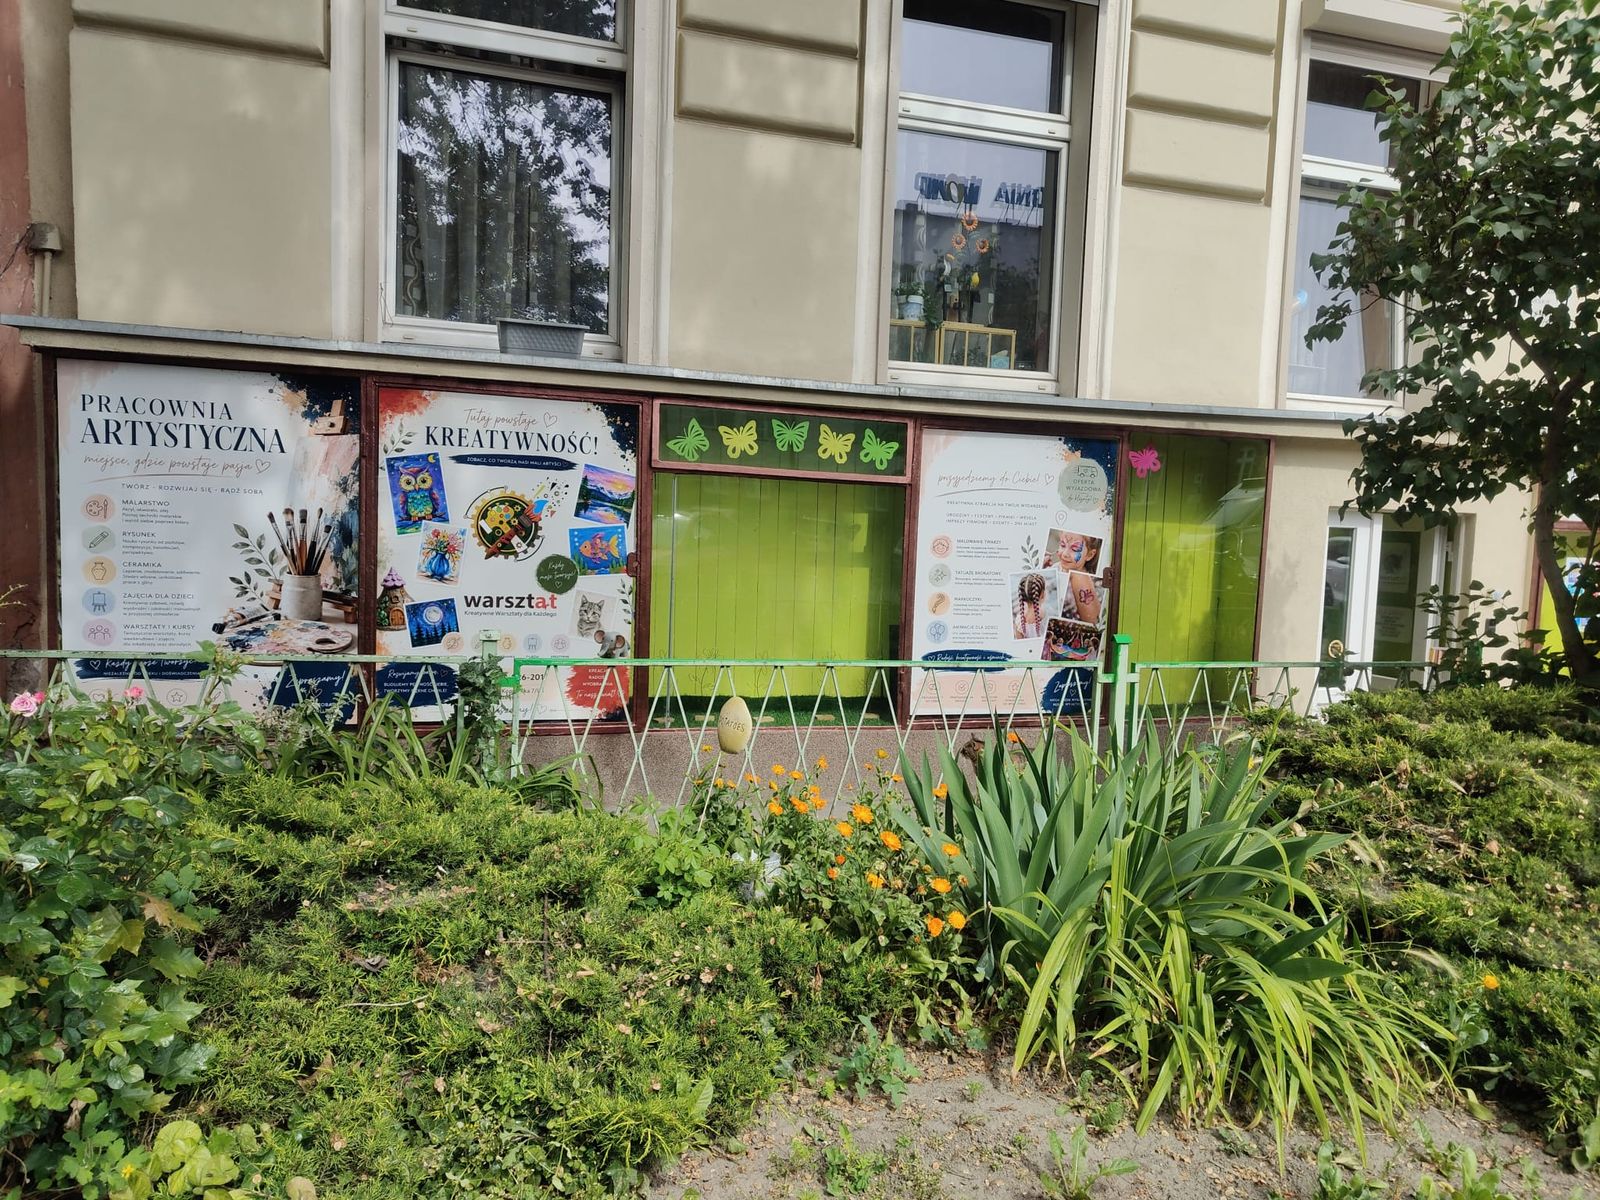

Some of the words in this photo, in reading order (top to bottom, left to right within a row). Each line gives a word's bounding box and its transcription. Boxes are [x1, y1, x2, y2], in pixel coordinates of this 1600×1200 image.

[81, 394, 233, 420] PRACOWNIA
[463, 408, 492, 428] Tutaj
[493, 411, 538, 431] powstaje
[80, 417, 287, 454] ARTYSTYCZNA
[425, 425, 599, 455] KREATYWNOŚĆ!
[168, 456, 218, 476] powstaje
[463, 593, 558, 610] warsztat
[495, 610, 523, 618] Warsztaty
